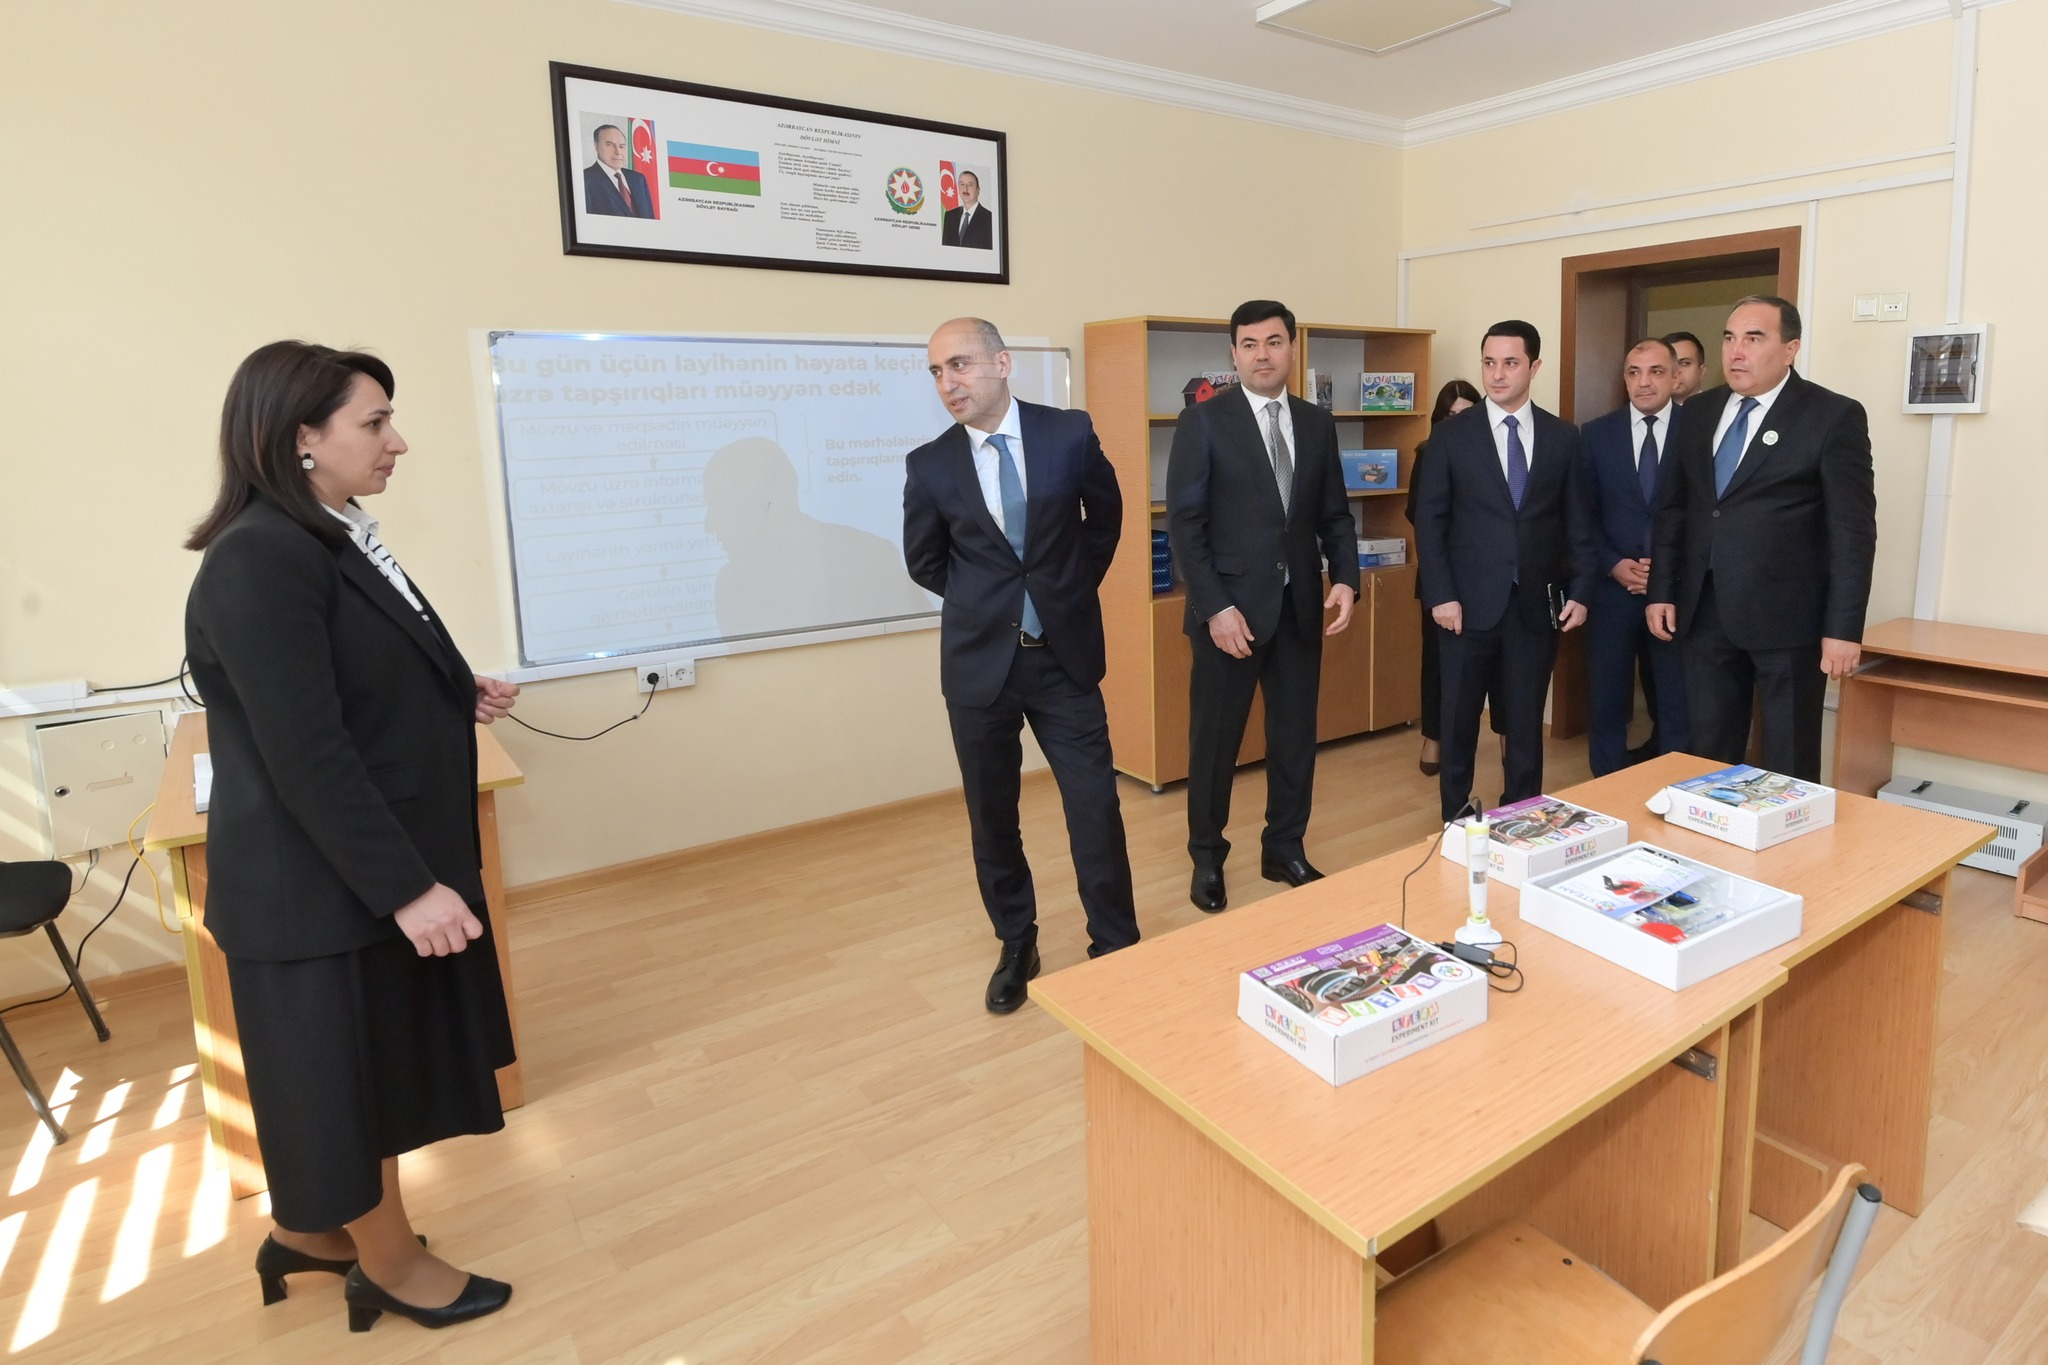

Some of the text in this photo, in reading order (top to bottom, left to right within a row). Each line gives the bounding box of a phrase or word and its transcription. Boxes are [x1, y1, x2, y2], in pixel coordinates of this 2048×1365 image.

[535, 353, 592, 378] gün
[600, 353, 668, 378] üçün
[675, 352, 788, 377] layihənin
[796, 353, 868, 375] həyata
[561, 382, 708, 406] tapşırıqları
[715, 380, 823, 402] müəyyən
[829, 379, 882, 397] edək
[520, 416, 767, 437] Mövzu və məqsədin müəyyən
[616, 437, 686, 452] edilməsi
[825, 439, 845, 450] Bu
[540, 481, 597, 495] Mövzu
[603, 477, 639, 490] üzrə
[828, 471, 862, 484] edin.
[596, 499, 616, 510] və
[545, 545, 630, 564] Layihənin
[633, 540, 684, 557] yerinə
[1688, 815, 1729, 833] EXPERIMENT KIT
[1318, 972, 1441, 1027] STEAM
[1265, 1004, 1307, 1042] STEAM
[1392, 1001, 1440, 1033] STEAM
[1265, 1018, 1307, 1052] EXPERIMENT KIT
[1391, 1022, 1428, 1043] EXPERIMENT
[1430, 1017, 1440, 1026] KIT
